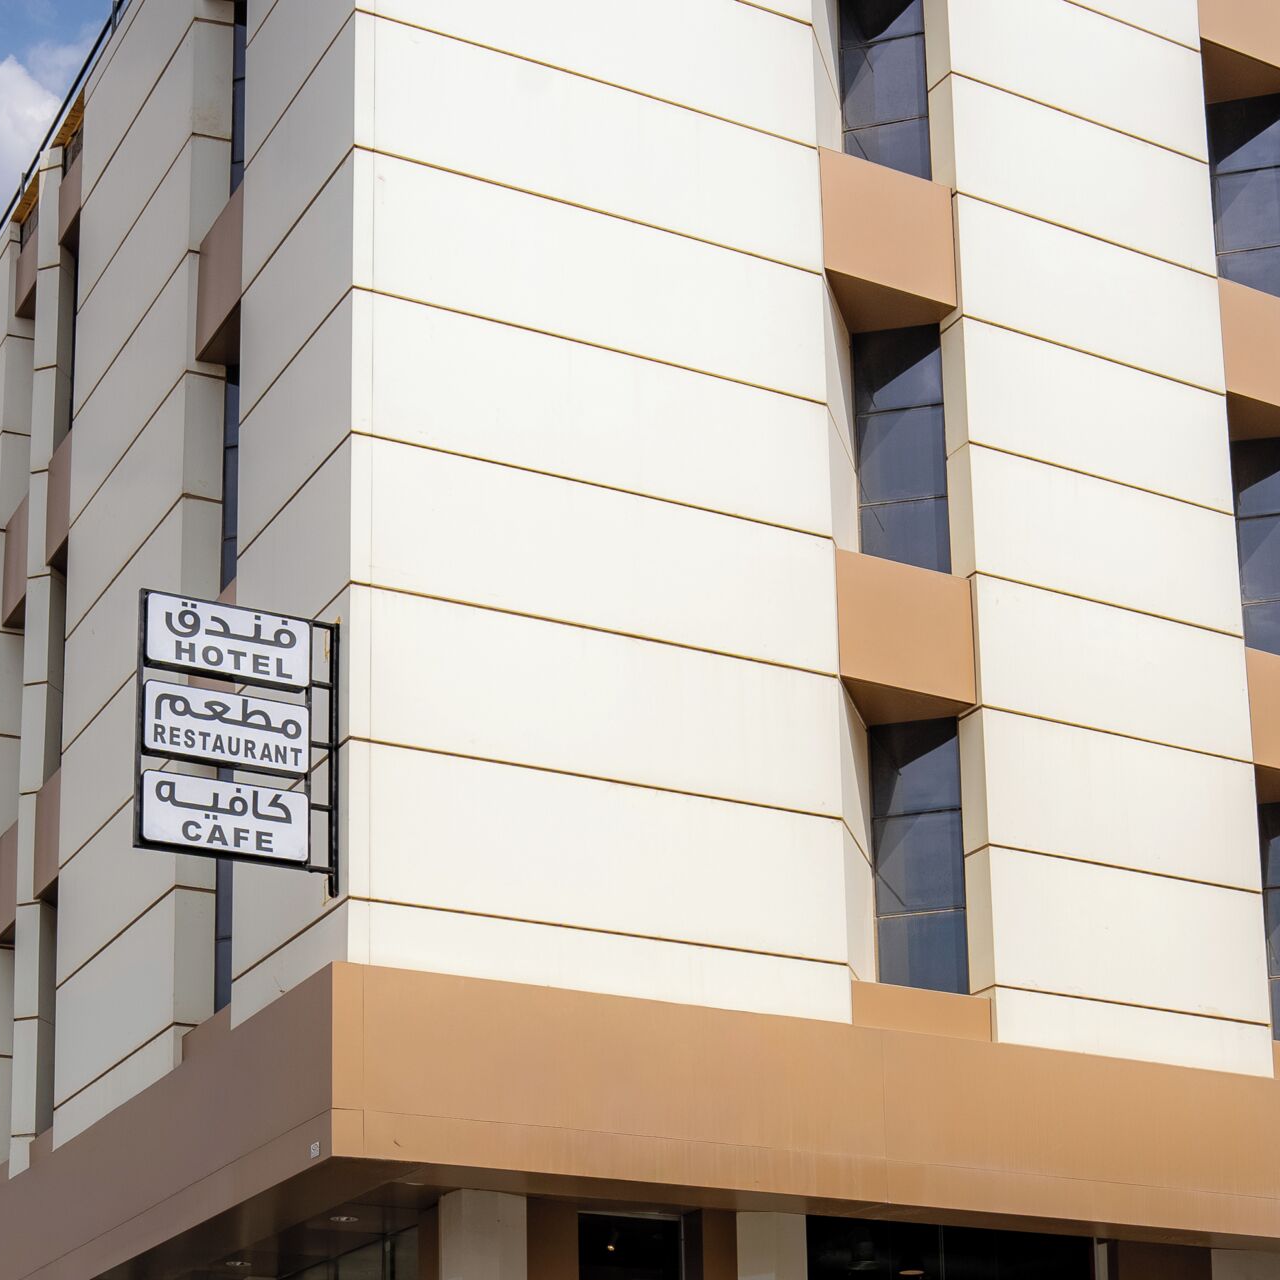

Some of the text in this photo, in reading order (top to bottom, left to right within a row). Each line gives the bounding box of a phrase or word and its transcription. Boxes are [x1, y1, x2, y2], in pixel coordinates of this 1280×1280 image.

[165, 601, 297, 649] فندق
[175, 640, 293, 679] HOTEL
[154, 693, 302, 740] مطعم
[153, 723, 303, 766] RESTAURANT
[155, 780, 293, 824] كافيه
[181, 820, 274, 853] CAFE
